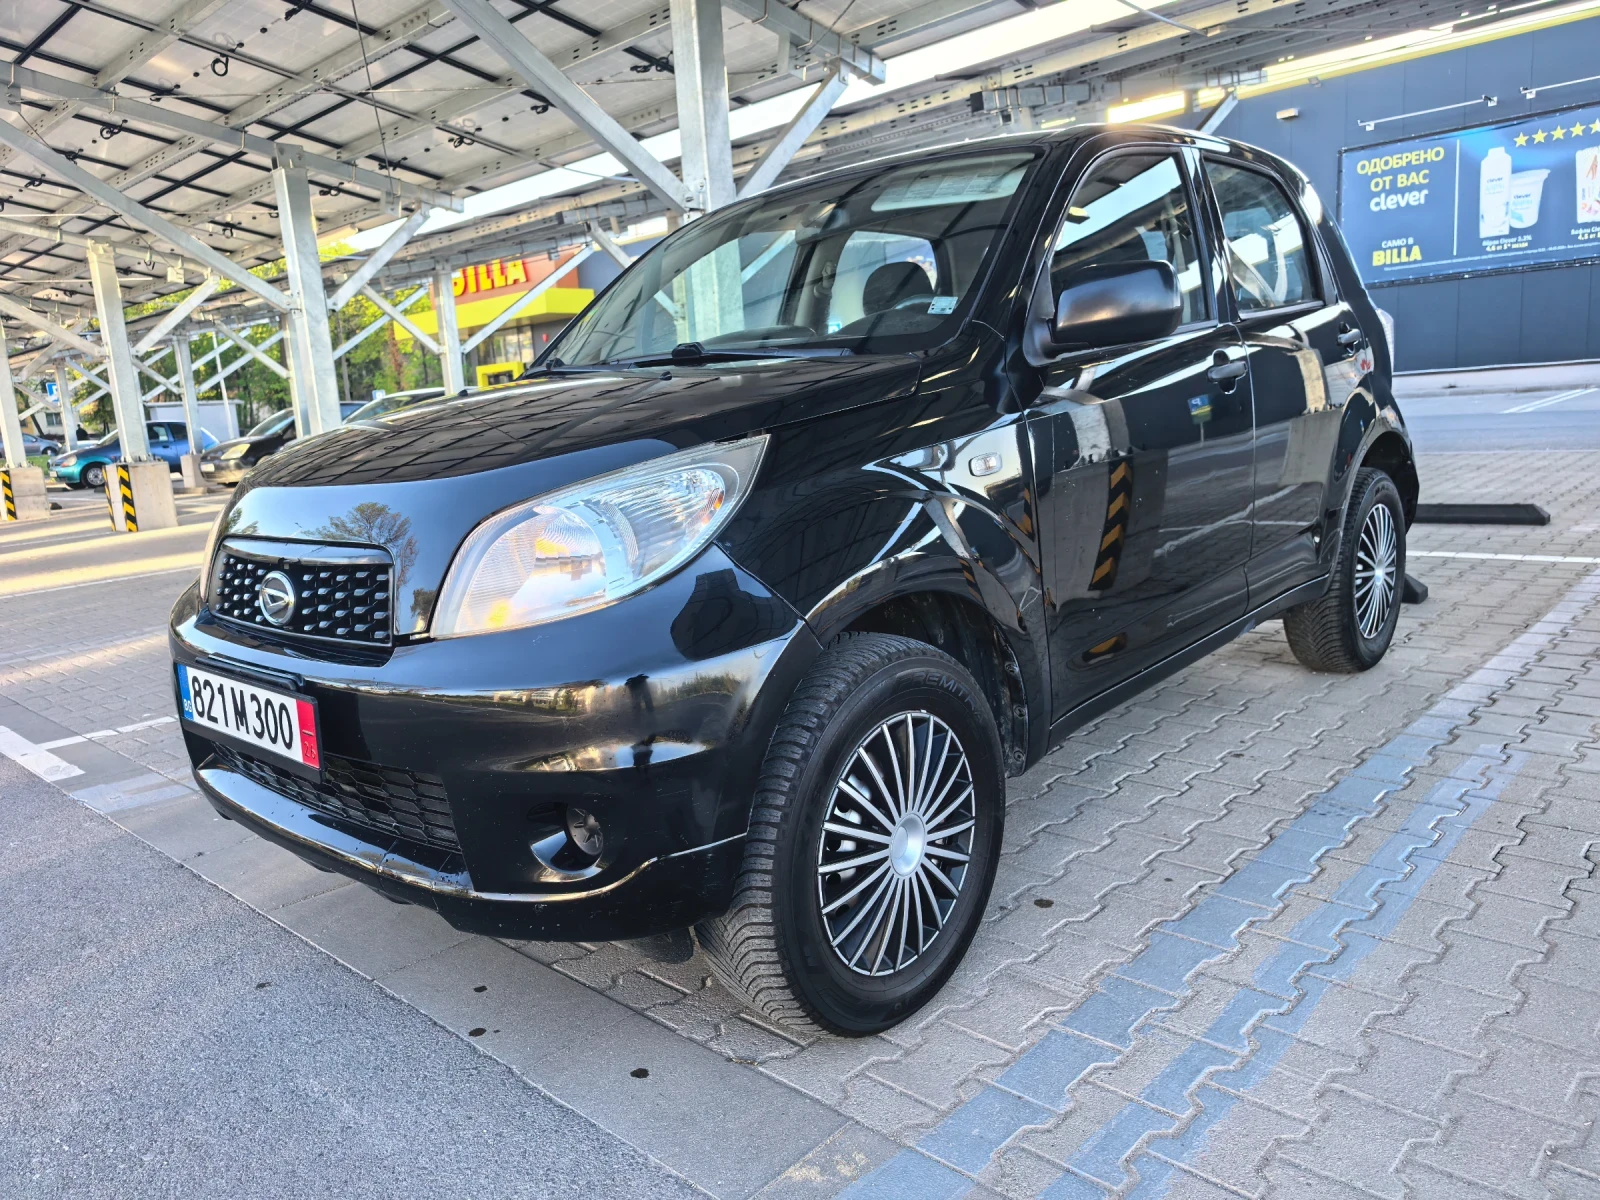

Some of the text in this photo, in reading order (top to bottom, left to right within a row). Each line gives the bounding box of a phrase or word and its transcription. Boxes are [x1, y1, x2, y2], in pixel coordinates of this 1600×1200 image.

[1356, 146, 1445, 176] ОДОБРЕНО
[1370, 169, 1430, 192] ОТ ВАС
[1369, 189, 1429, 212] clever
[1381, 236, 1414, 249] САМО В
[1371, 244, 1423, 267] BILLA
[183, 675, 294, 750] BG 821M300
